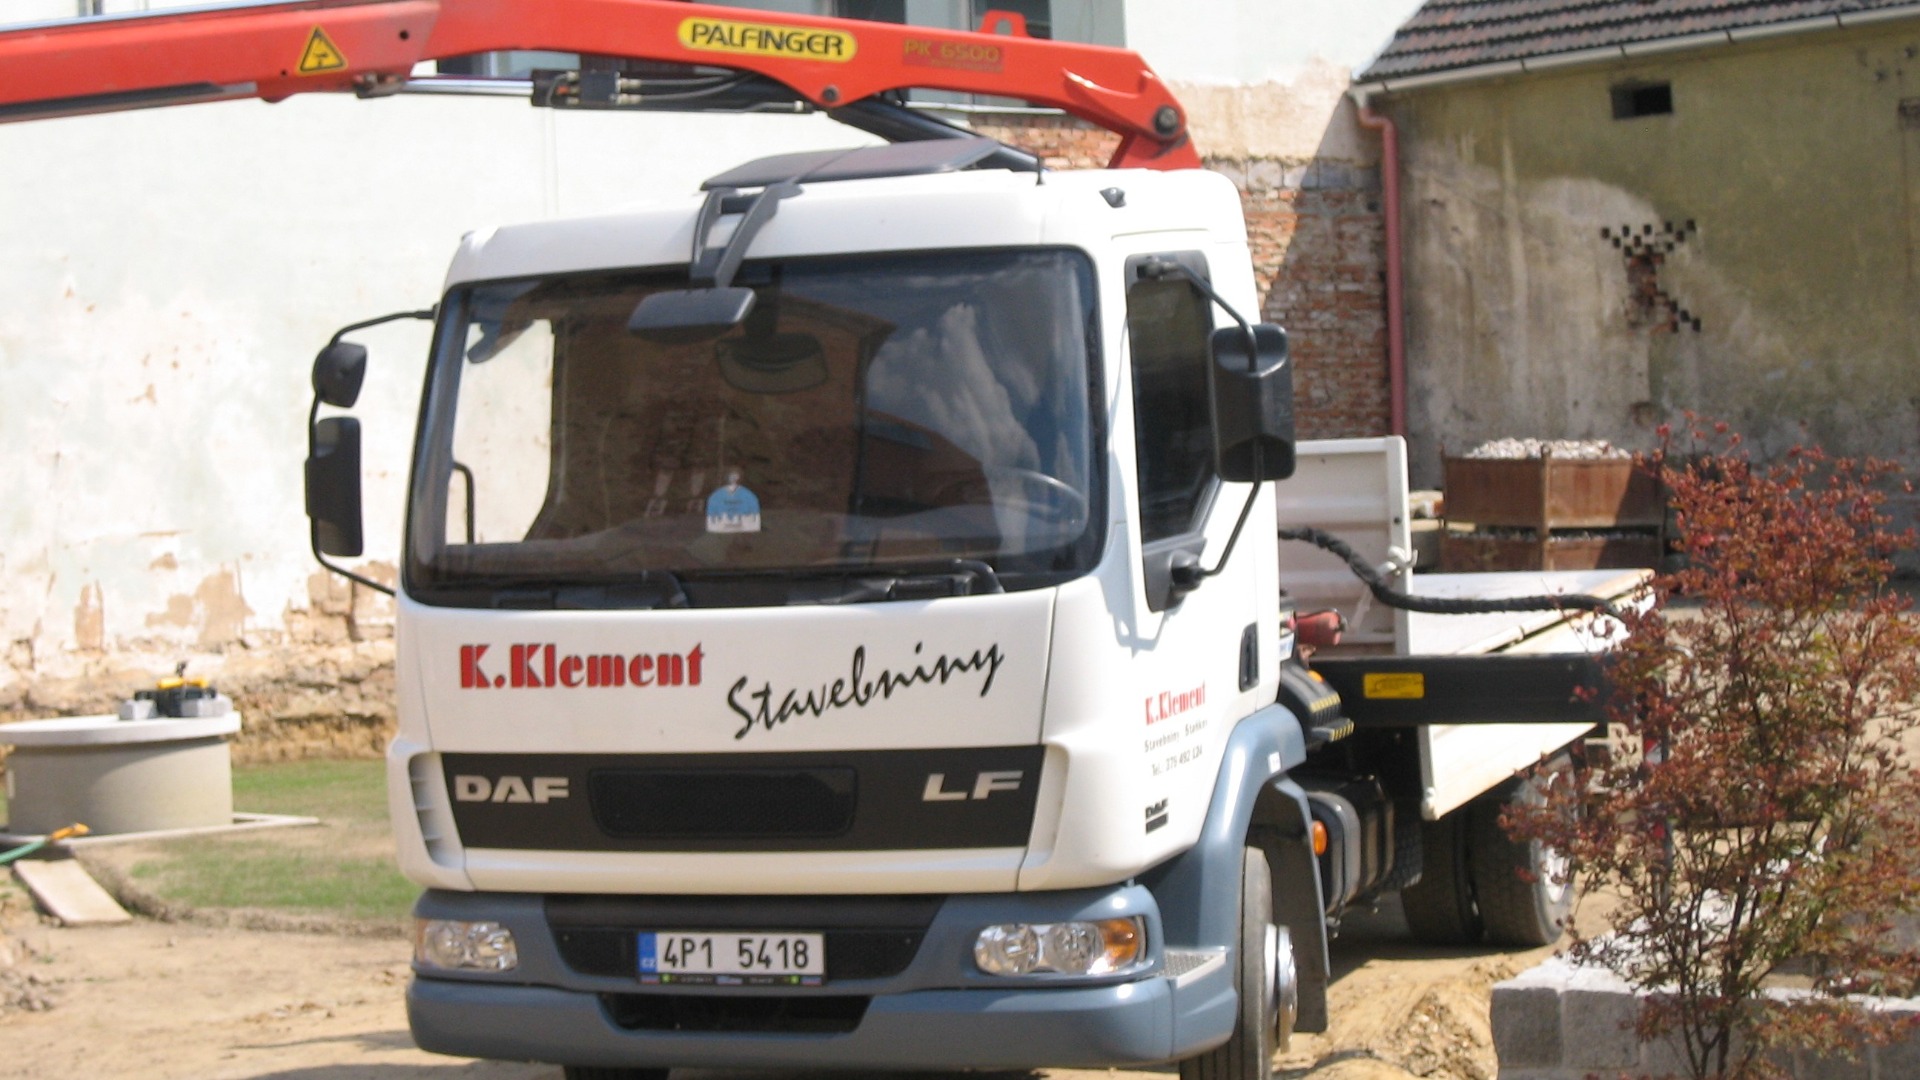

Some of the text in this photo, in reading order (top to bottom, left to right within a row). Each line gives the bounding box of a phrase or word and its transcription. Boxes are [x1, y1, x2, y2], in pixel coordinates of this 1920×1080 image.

[690, 22, 844, 56] PALFINGER
[904, 39, 999, 62] PK 6500
[460, 642, 704, 688] K.Klement
[727, 641, 1004, 740] Stavebniny
[1145, 681, 1206, 726] K.Klement
[455, 774, 569, 803] DAF
[922, 770, 1024, 801] LF
[1145, 798, 1168, 820] DAF
[641, 959, 657, 968] CZ
[663, 938, 809, 969] 4P1 5418
